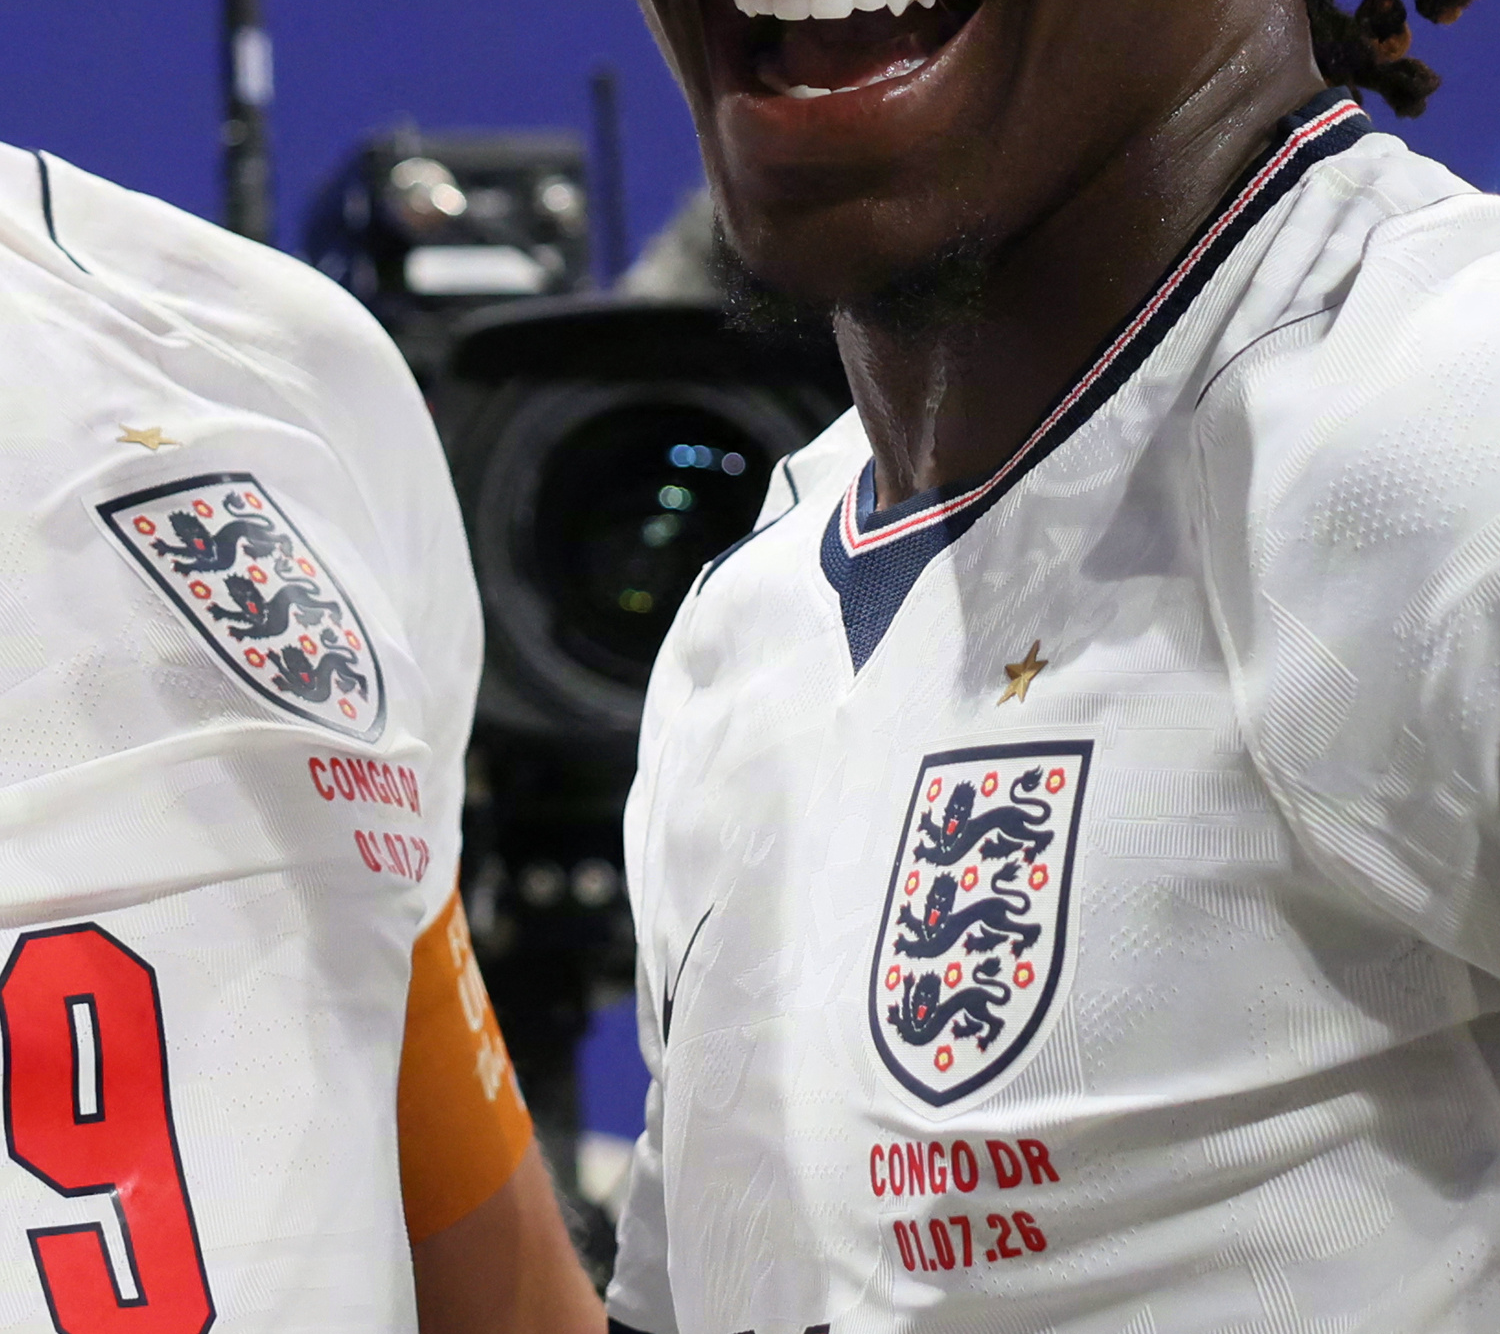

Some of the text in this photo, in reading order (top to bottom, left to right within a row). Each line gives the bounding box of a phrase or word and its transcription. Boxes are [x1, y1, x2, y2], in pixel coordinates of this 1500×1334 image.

[308, 756, 404, 807] CONGO
[869, 1136, 1060, 1197] CONGO DR
[891, 1209, 1048, 1274] 01.07.26
